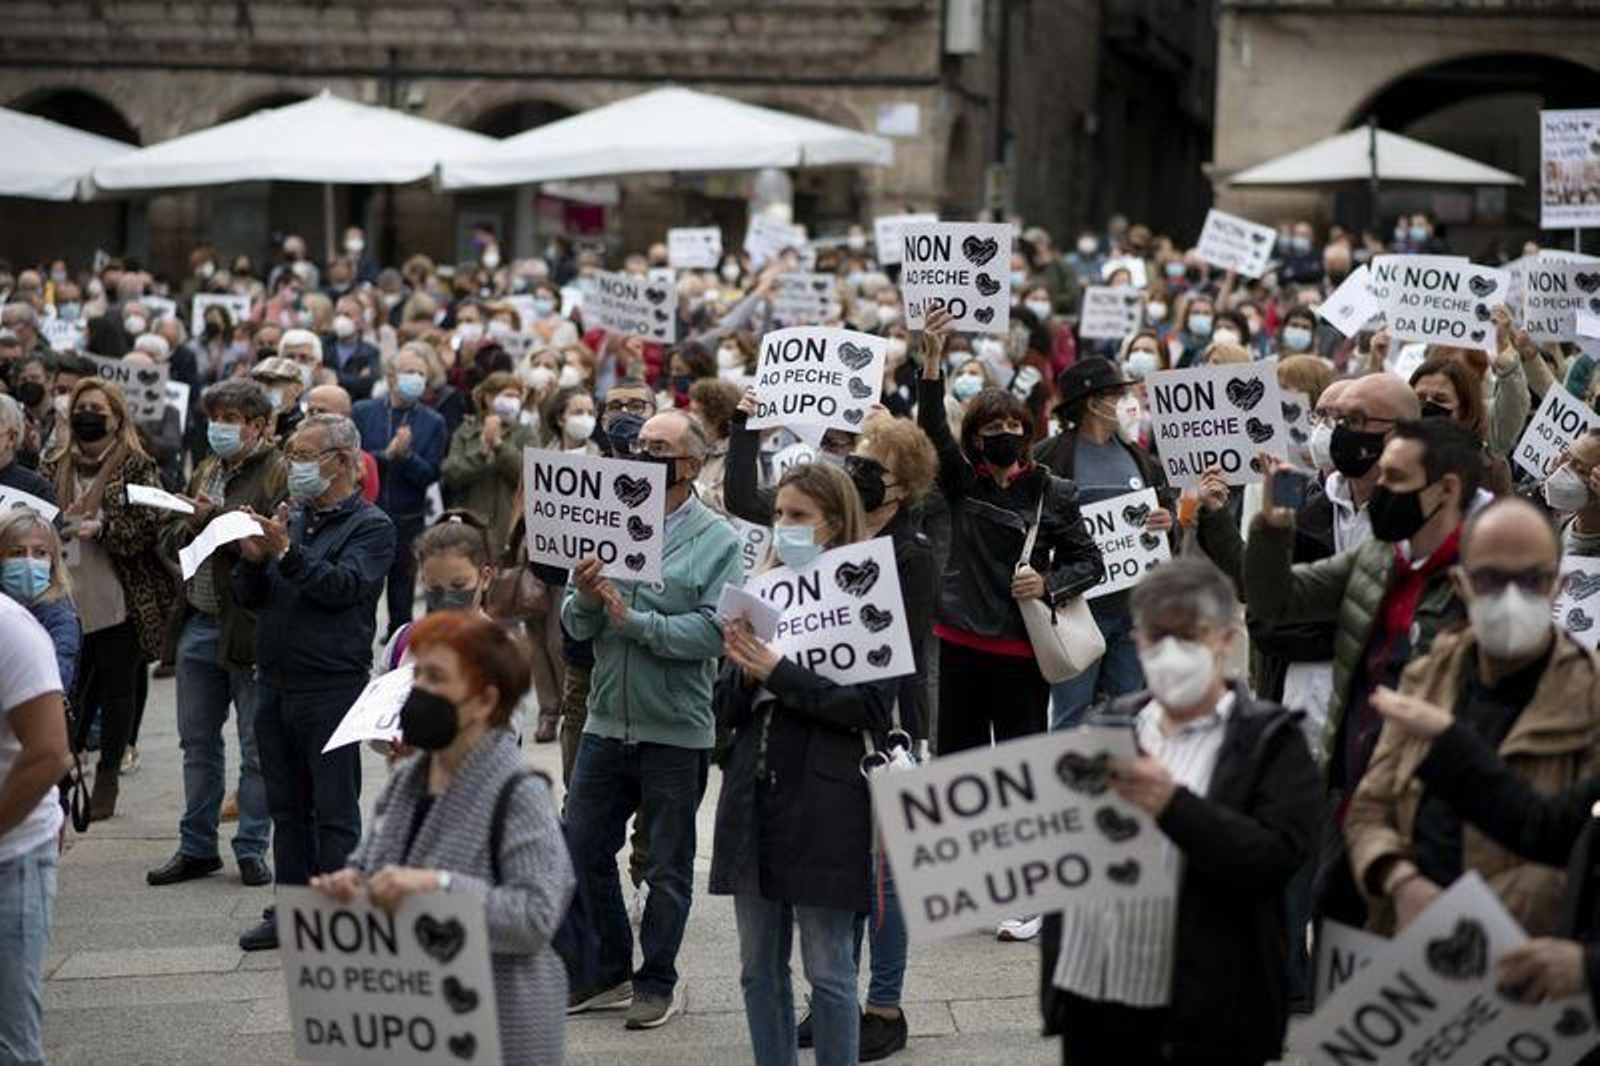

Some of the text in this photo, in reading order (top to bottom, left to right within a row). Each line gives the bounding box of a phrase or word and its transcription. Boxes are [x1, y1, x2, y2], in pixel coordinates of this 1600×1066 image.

[905, 235, 951, 262] NON
[601, 277, 638, 300] NON
[921, 269, 970, 286] PECHE
[1404, 266, 1460, 292] NON
[1528, 271, 1567, 292] NON
[1400, 293, 1471, 312] AO PECHE
[1543, 297, 1584, 309] PECHE
[1395, 317, 1466, 338] DA UPO
[765, 338, 826, 366] NON
[101, 365, 130, 383] ON
[760, 368, 842, 386] AO PECHE
[757, 394, 837, 418] DA UPO
[1155, 380, 1215, 415] NON
[1160, 417, 1239, 439] AO PECHE
[1536, 422, 1553, 440] AO
[1168, 449, 1241, 476] DA UPO
[1522, 445, 1541, 466] DA
[535, 463, 602, 500] NON
[533, 501, 621, 528] AO PECHE
[1084, 511, 1115, 536] ON
[535, 534, 618, 563] DA UPO
[743, 529, 764, 570] UPO
[1097, 535, 1136, 554] ECHE
[760, 570, 822, 610] ON
[776, 607, 852, 639] PECHE
[899, 761, 1038, 831] NON
[912, 807, 1084, 868] AO PECHE
[922, 853, 1091, 922] DA UPO
[294, 909, 399, 955] NON
[300, 966, 434, 996] AO PECHE
[1321, 971, 1438, 1066] NON
[305, 1013, 436, 1052] DA UPO
